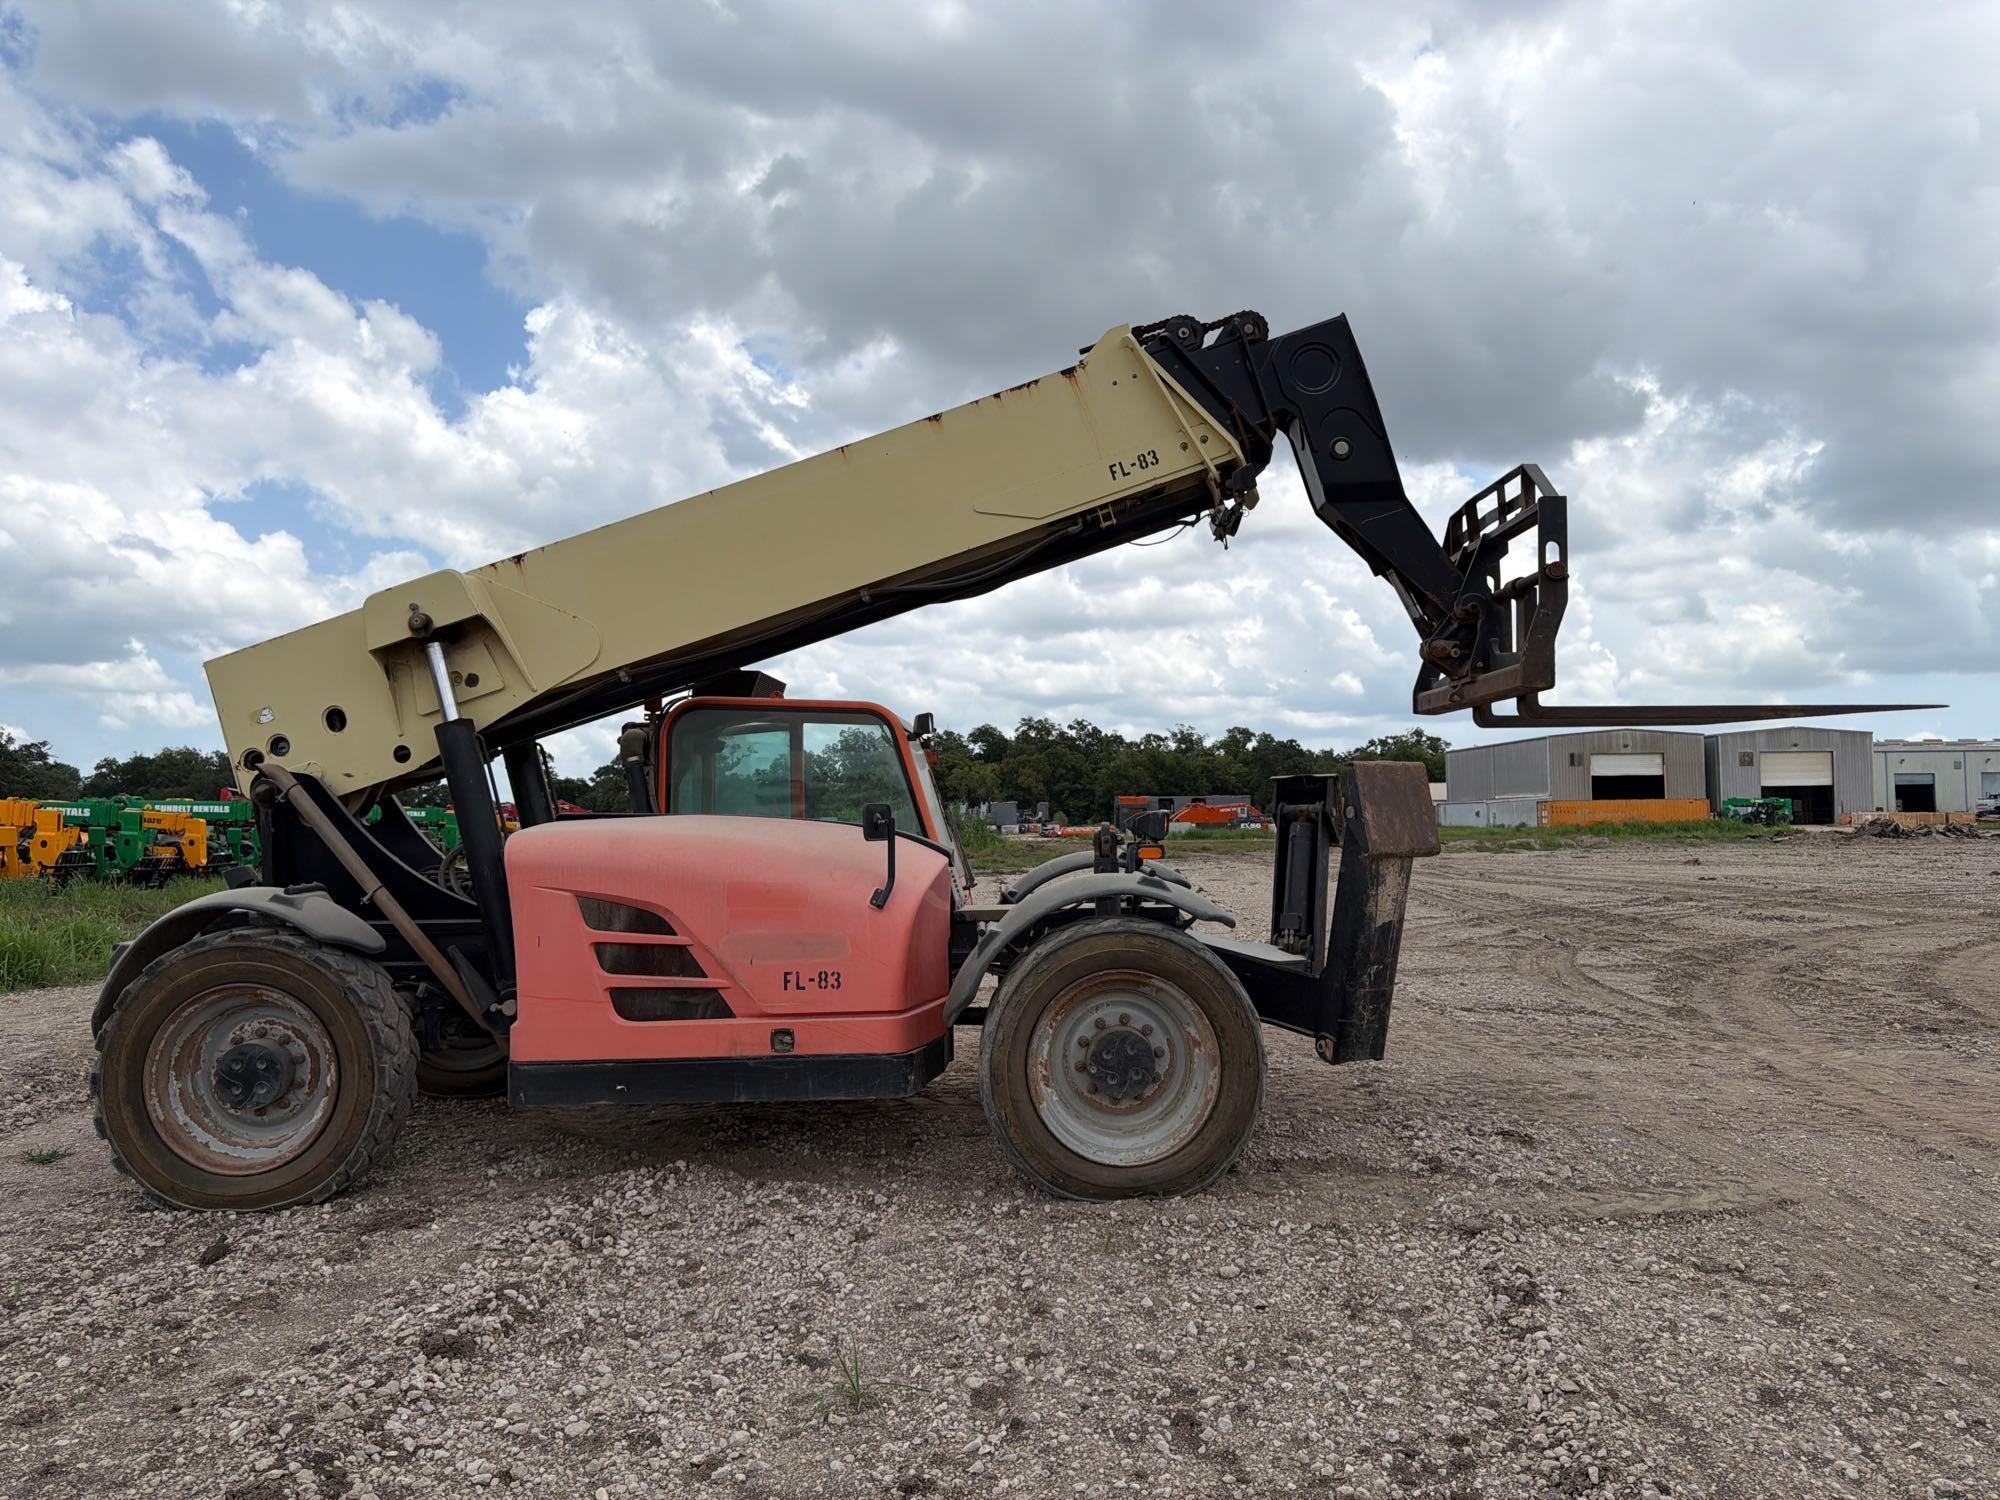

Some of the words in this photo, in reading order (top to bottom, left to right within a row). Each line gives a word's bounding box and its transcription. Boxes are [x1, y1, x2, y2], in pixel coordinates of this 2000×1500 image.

[1108, 449, 1160, 481] FL-83
[154, 804, 192, 812] SUNBELT
[192, 805, 230, 813] RENTALS
[783, 970, 842, 991] FL-83
